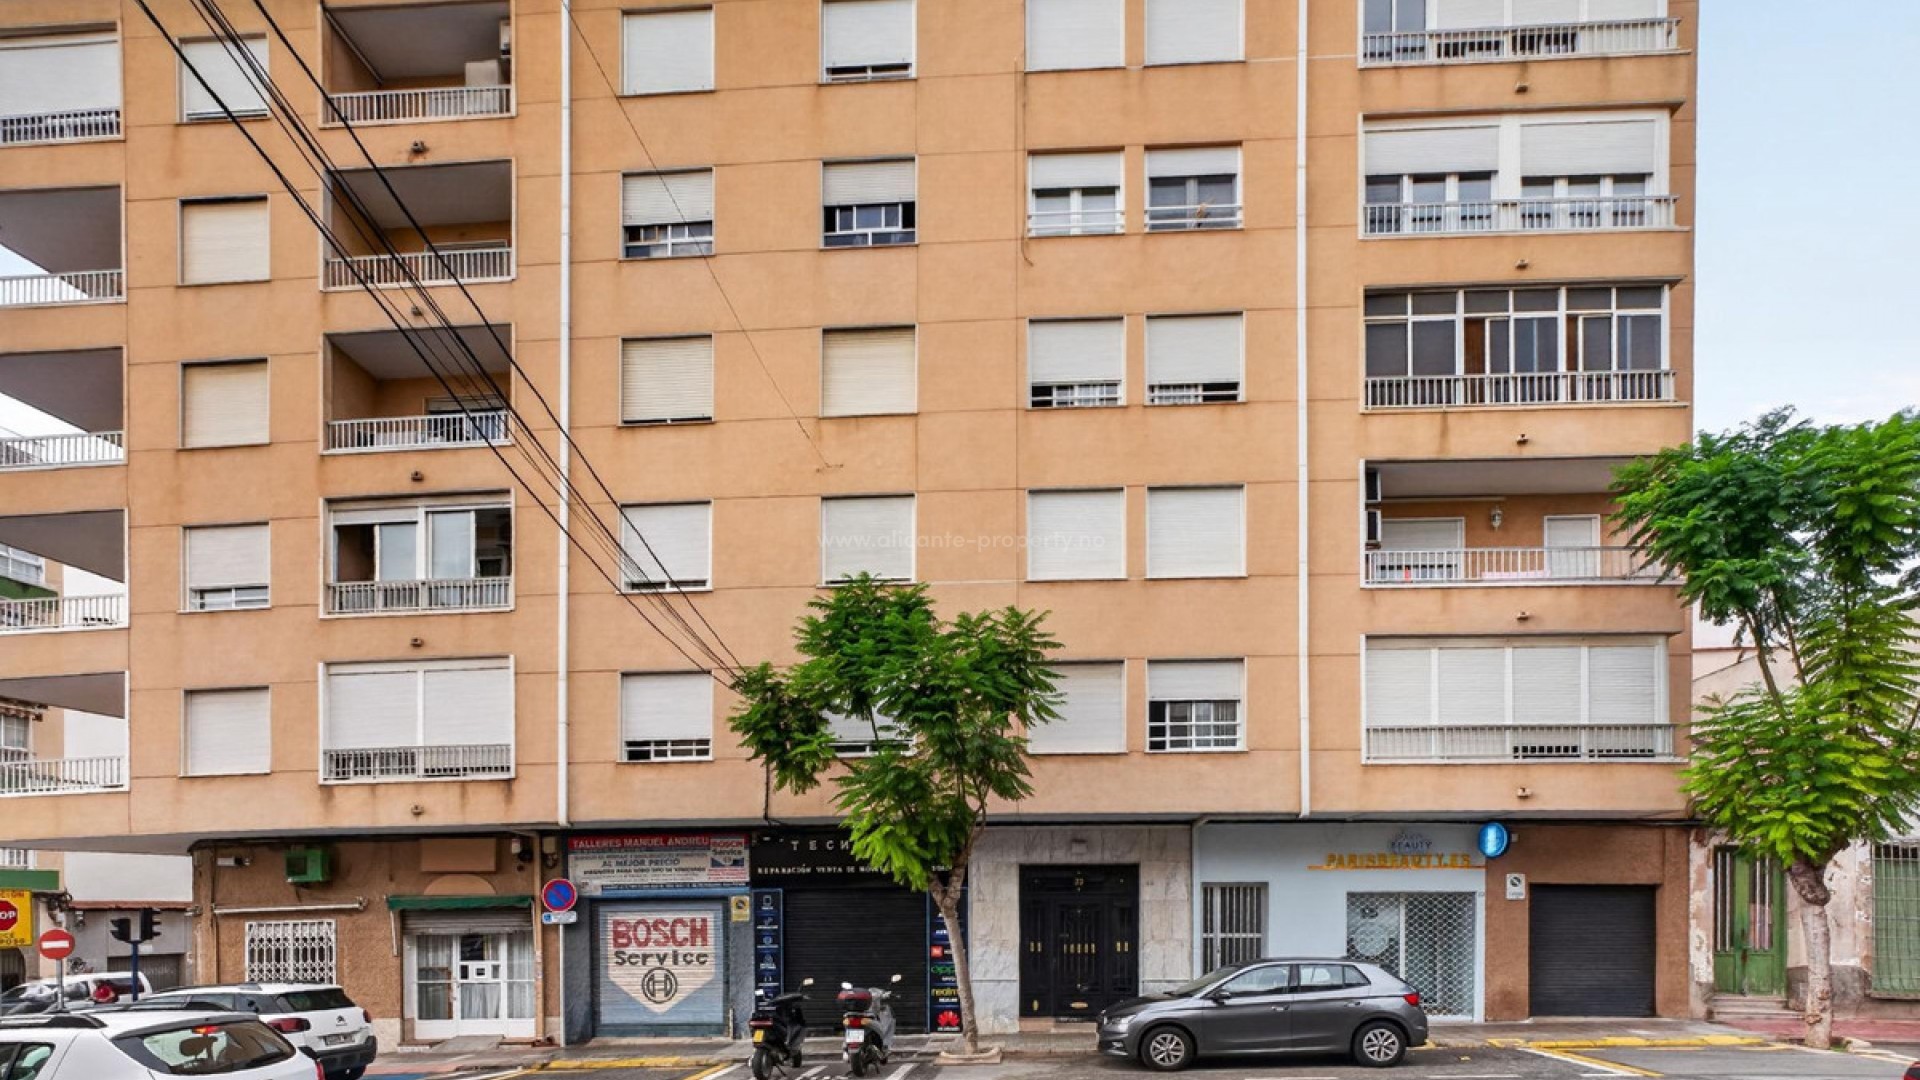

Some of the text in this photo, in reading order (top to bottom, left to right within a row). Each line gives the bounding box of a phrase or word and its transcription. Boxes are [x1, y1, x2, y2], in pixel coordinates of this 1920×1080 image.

[573, 836, 709, 849] TALLERES MANUEL ANDREU
[615, 859, 646, 867] MEJOR
[648, 858, 681, 866] PRECIO
[757, 864, 812, 875] REPARACIÓN
[815, 865, 843, 874] VENTA
[846, 865, 856, 874] DE
[612, 917, 708, 948] BOSCH
[613, 950, 709, 966] Service
